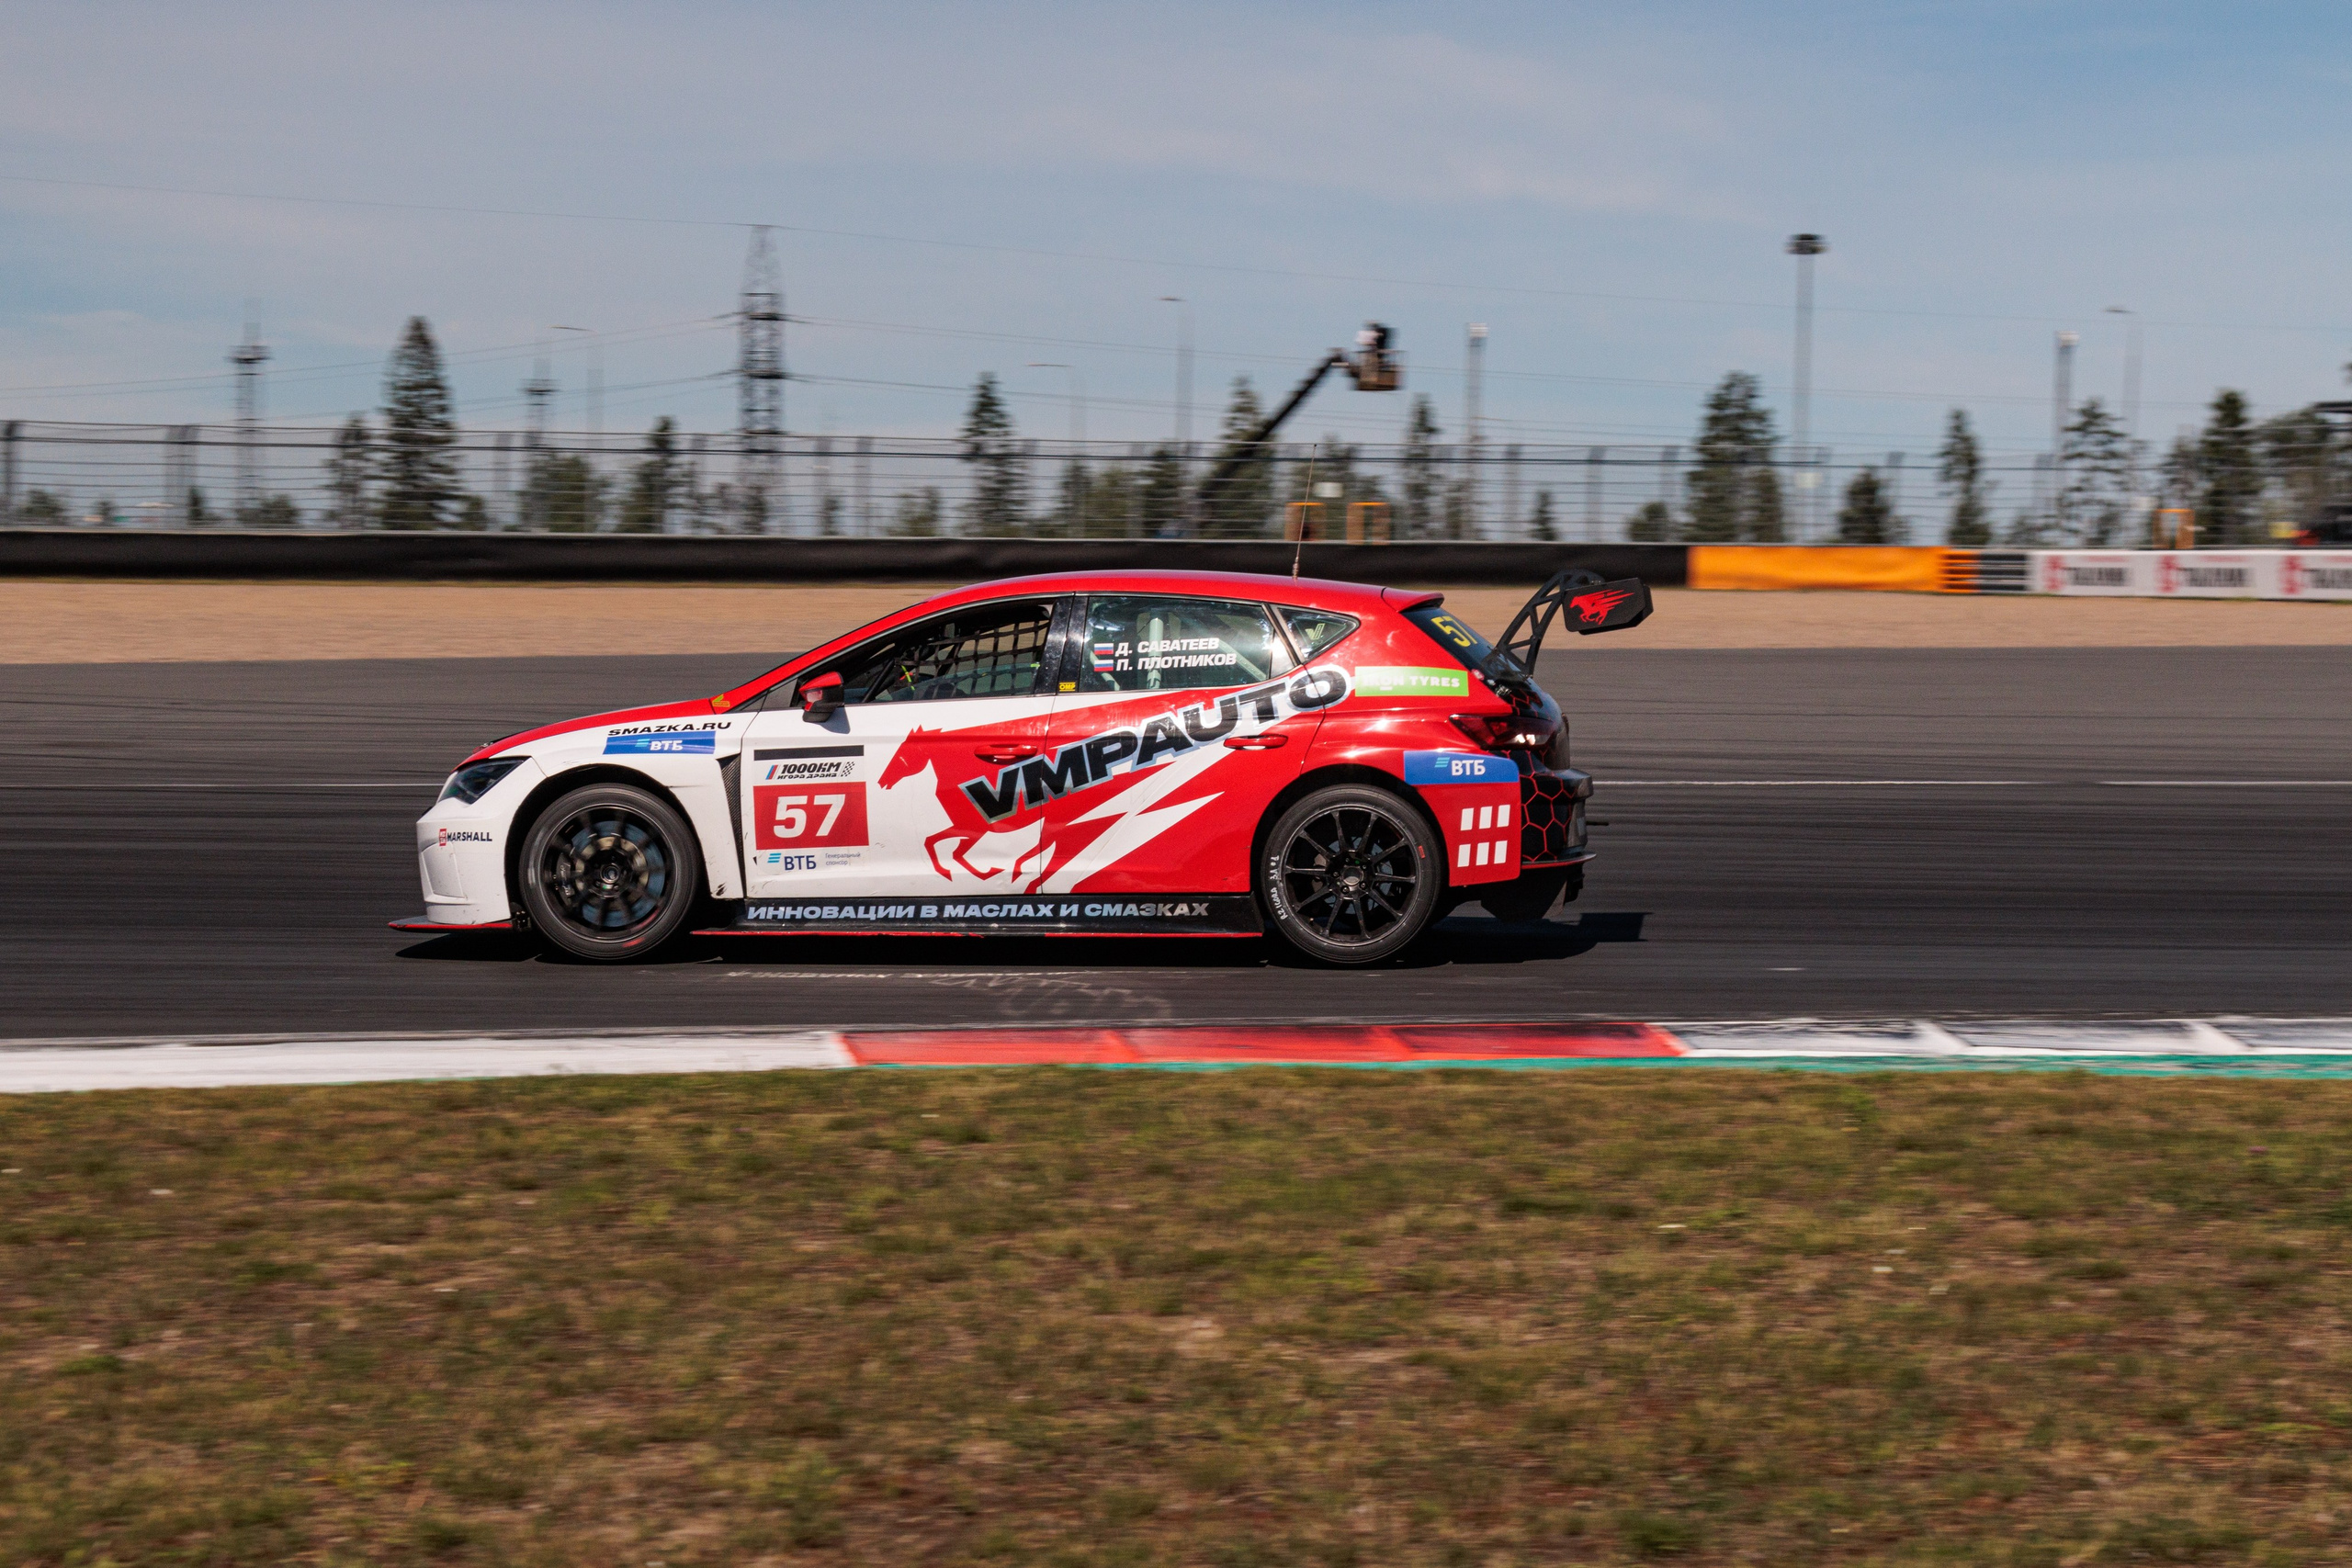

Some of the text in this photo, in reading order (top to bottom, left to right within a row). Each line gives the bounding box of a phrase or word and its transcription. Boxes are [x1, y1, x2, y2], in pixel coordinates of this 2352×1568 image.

[1114, 637, 1220, 657] Д. САВАТЕЕВ
[1116, 653, 1237, 671] П. ПЛОТНИКОВ
[1409, 675, 1460, 687] TYRES
[608, 722, 731, 736] SMAZKA.RU
[650, 739, 684, 750] ВТБ
[962, 667, 1350, 821] VMPAUTO
[1452, 760, 1486, 775] ВТБ
[773, 794, 845, 839] 57
[447, 831, 492, 841] MARSHALL
[784, 855, 817, 871] ВТБ
[747, 903, 1210, 920] ИННОВАЦИИ В МАСЛАХ И СМАЗКАХ
